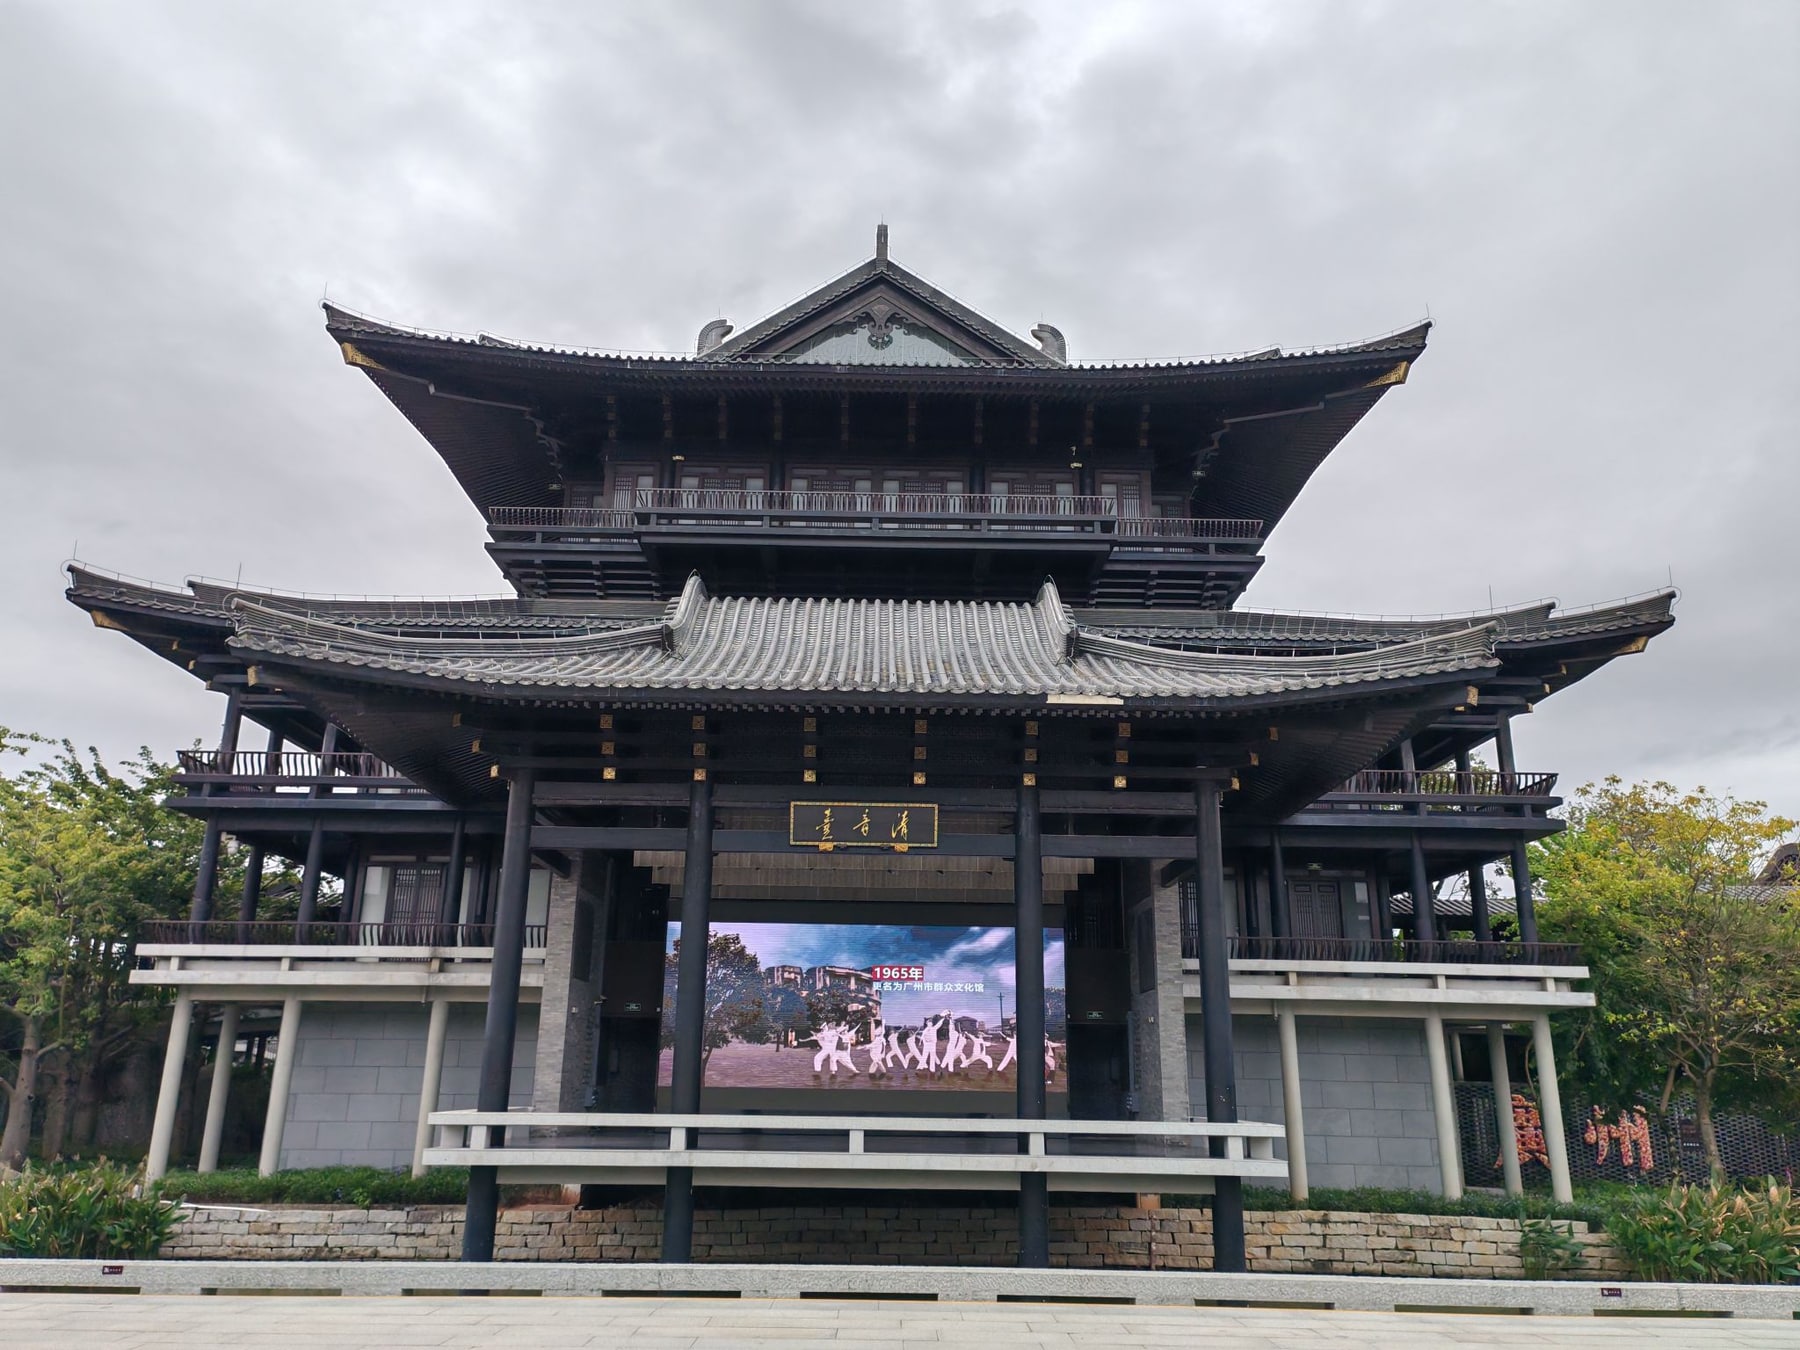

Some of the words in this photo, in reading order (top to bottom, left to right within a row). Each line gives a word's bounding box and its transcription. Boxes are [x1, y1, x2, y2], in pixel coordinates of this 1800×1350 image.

[874, 967, 923, 980] 1965年
[872, 981, 984, 992] 更名为广州市群众文化馆
